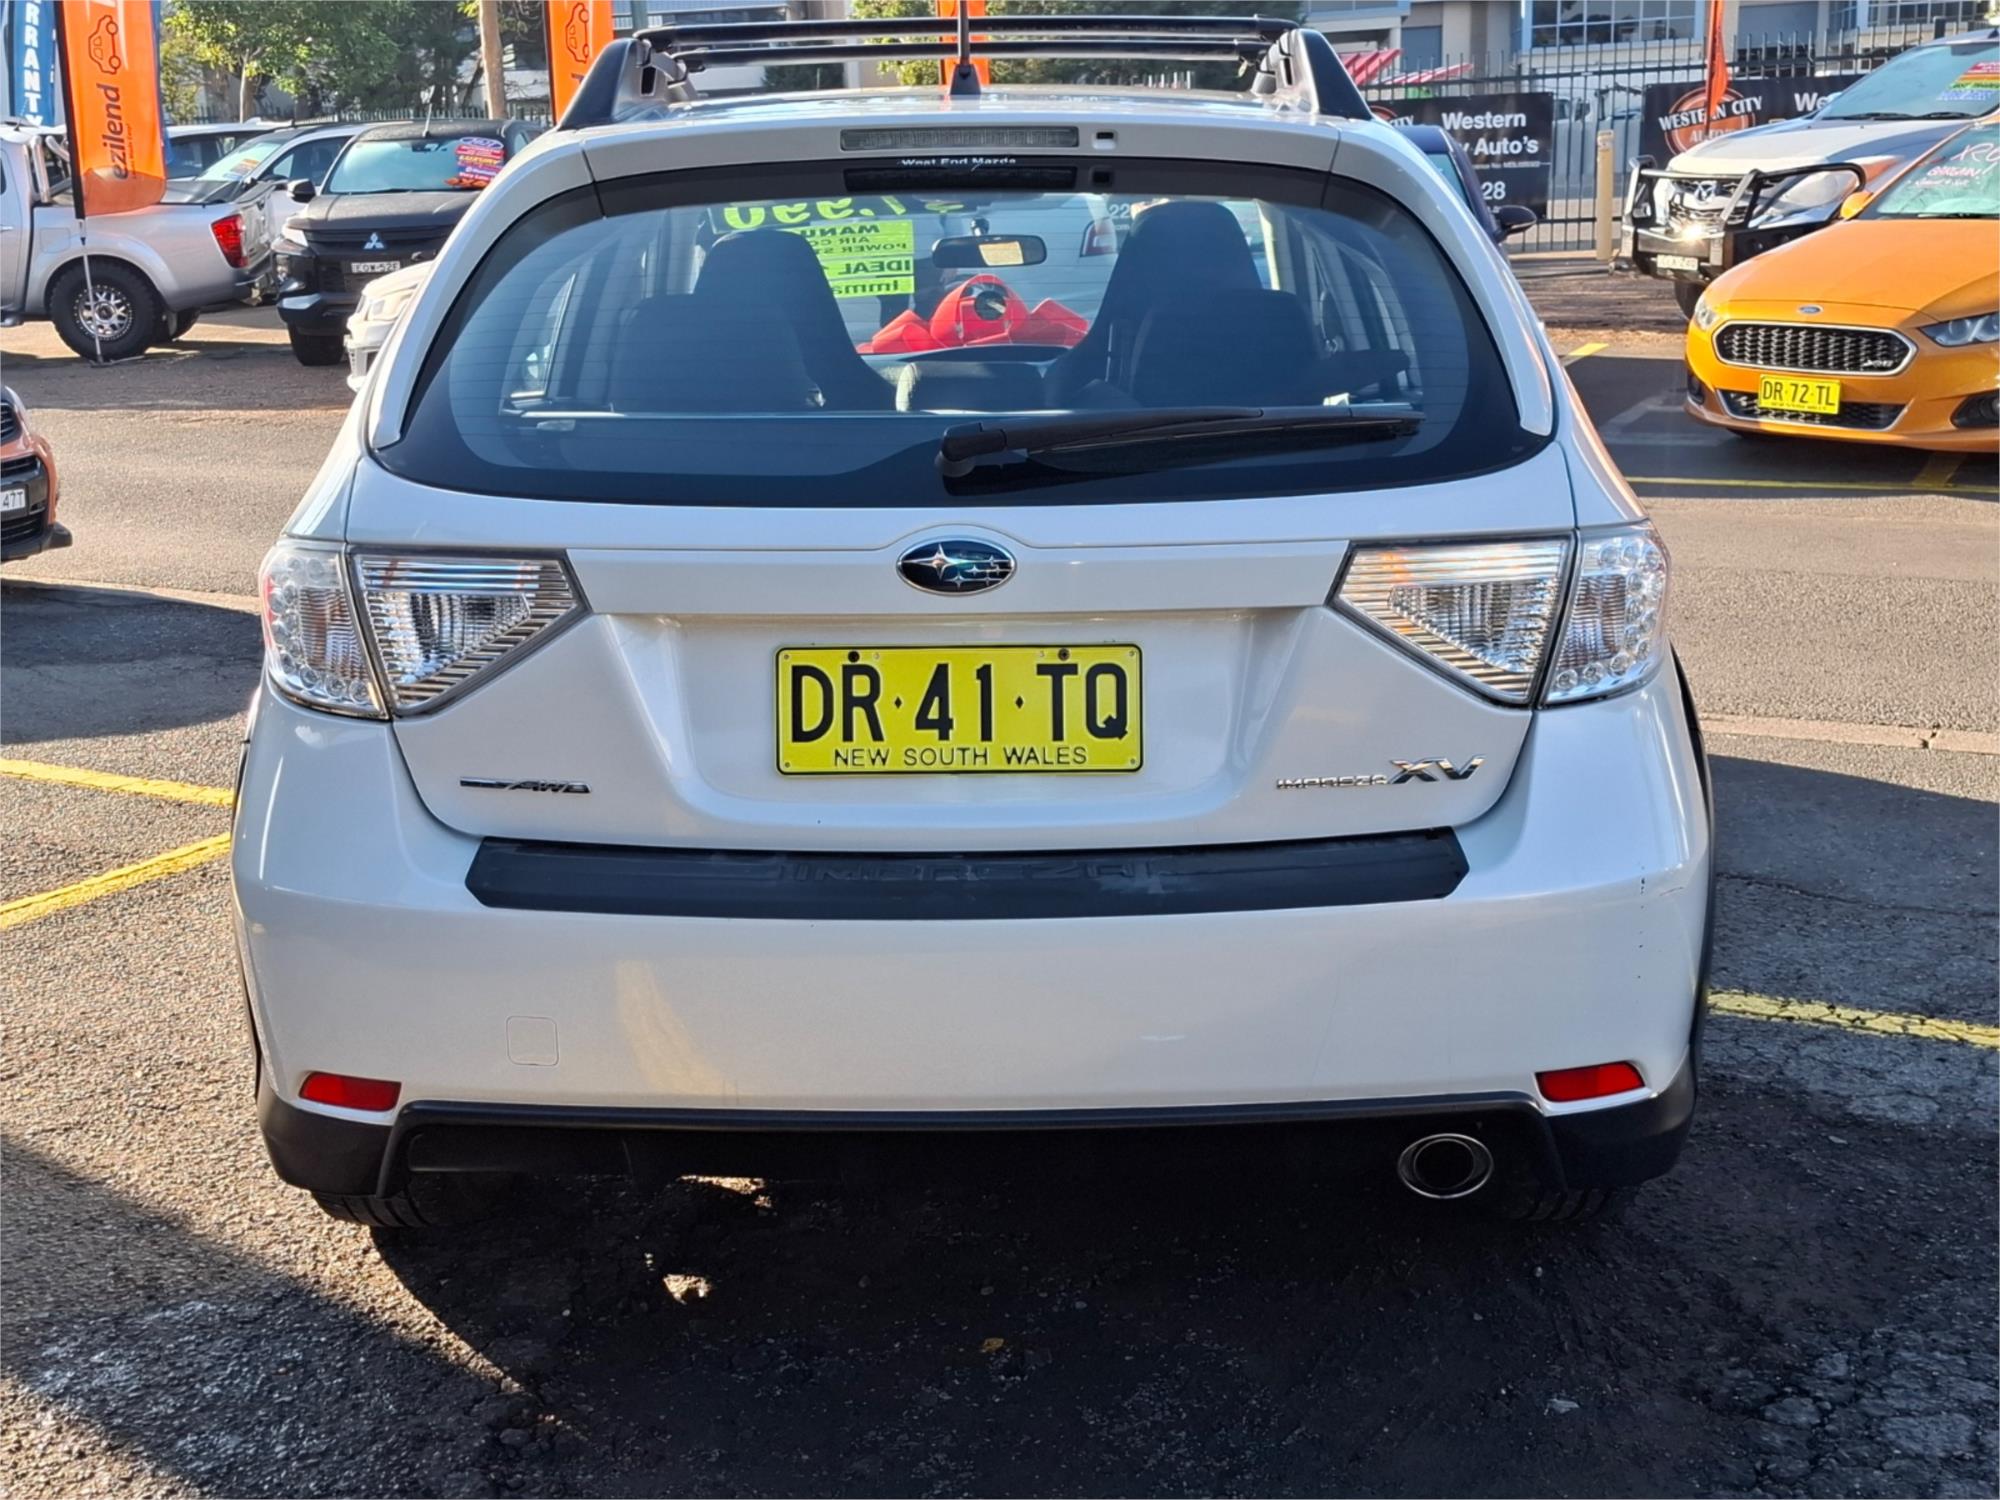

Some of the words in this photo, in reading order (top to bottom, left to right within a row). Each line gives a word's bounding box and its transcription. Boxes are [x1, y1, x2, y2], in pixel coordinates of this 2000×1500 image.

[1441, 111, 1527, 131] Western
[1659, 103, 1727, 131] WESTEN
[1732, 96, 1763, 114] CITY
[96, 83, 129, 180] ezilend
[1473, 136, 1539, 156] Auto's
[834, 748, 890, 767] NEW
[904, 747, 988, 766] SOUTH
[1003, 746, 1087, 765] WALES
[1276, 774, 1388, 789] IMPREZA
[1388, 753, 1486, 785] XV
